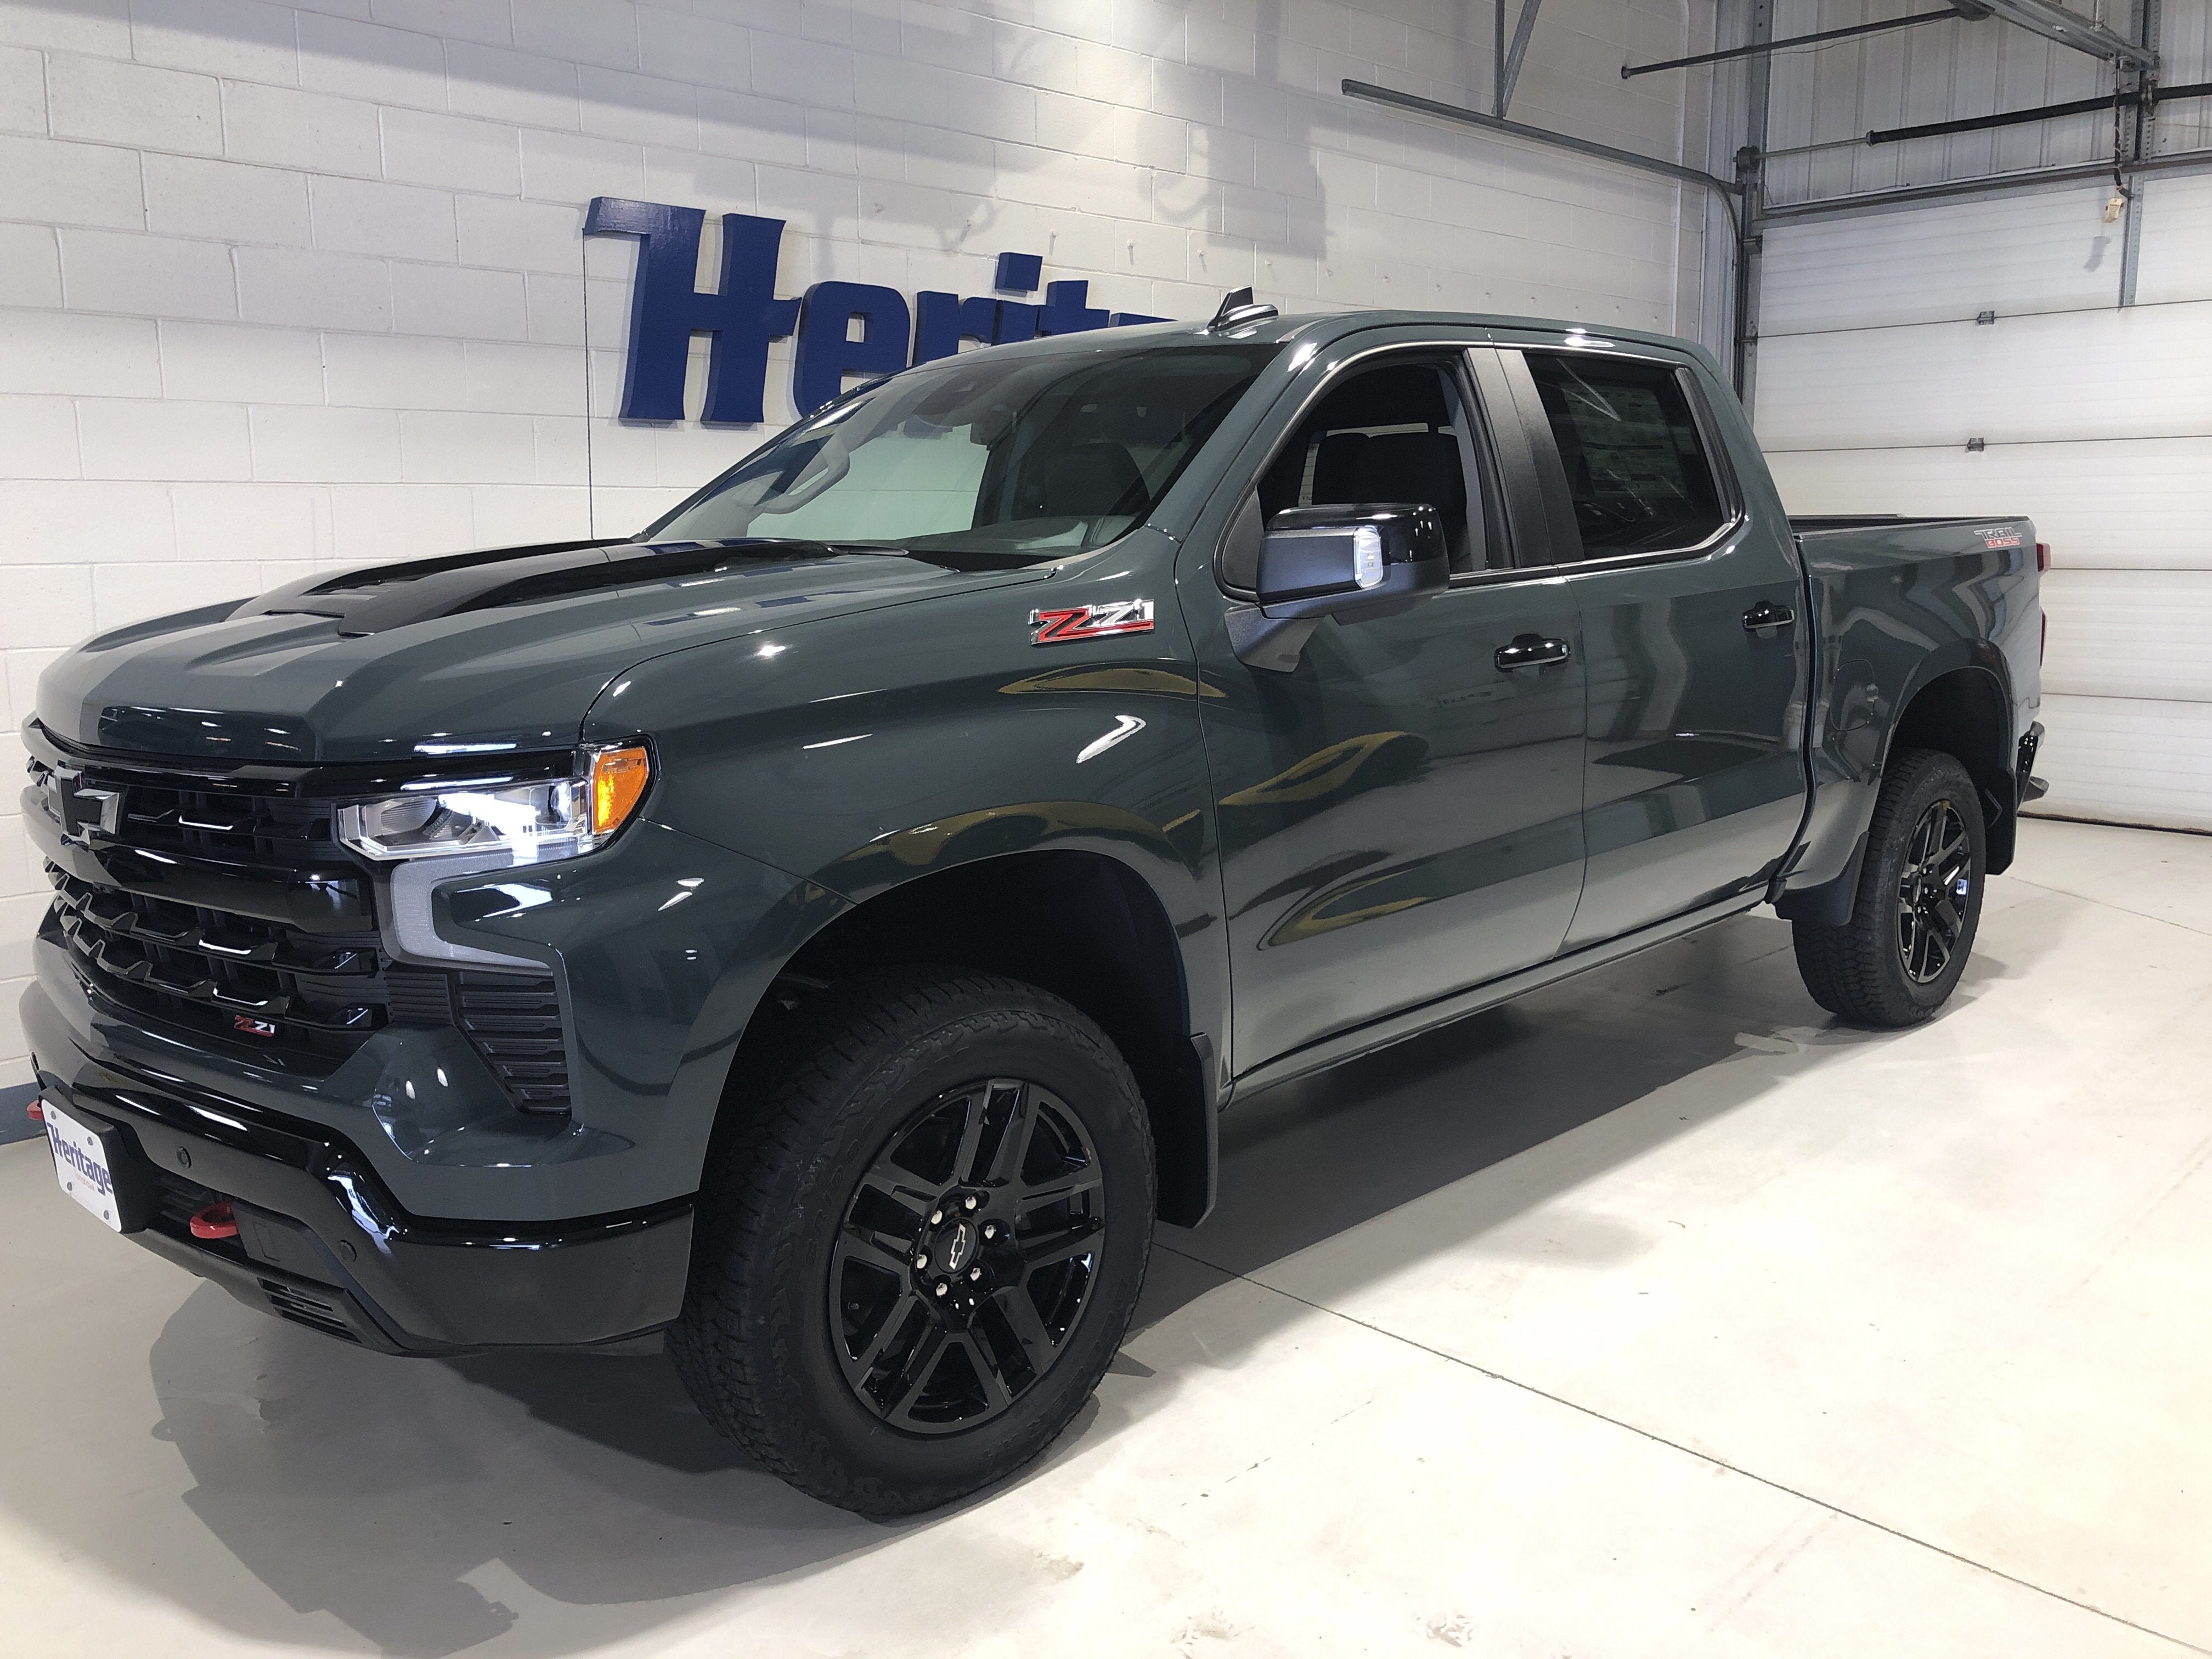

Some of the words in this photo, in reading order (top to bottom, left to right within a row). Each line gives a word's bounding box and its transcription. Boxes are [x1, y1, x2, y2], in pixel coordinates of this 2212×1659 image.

[1973, 527, 2022, 540] TRAIL
[1985, 537, 2021, 549] BOSS
[1028, 599, 1154, 646] Z71
[234, 1014, 275, 1037] Z71
[47, 1121, 113, 1196] Heritage
